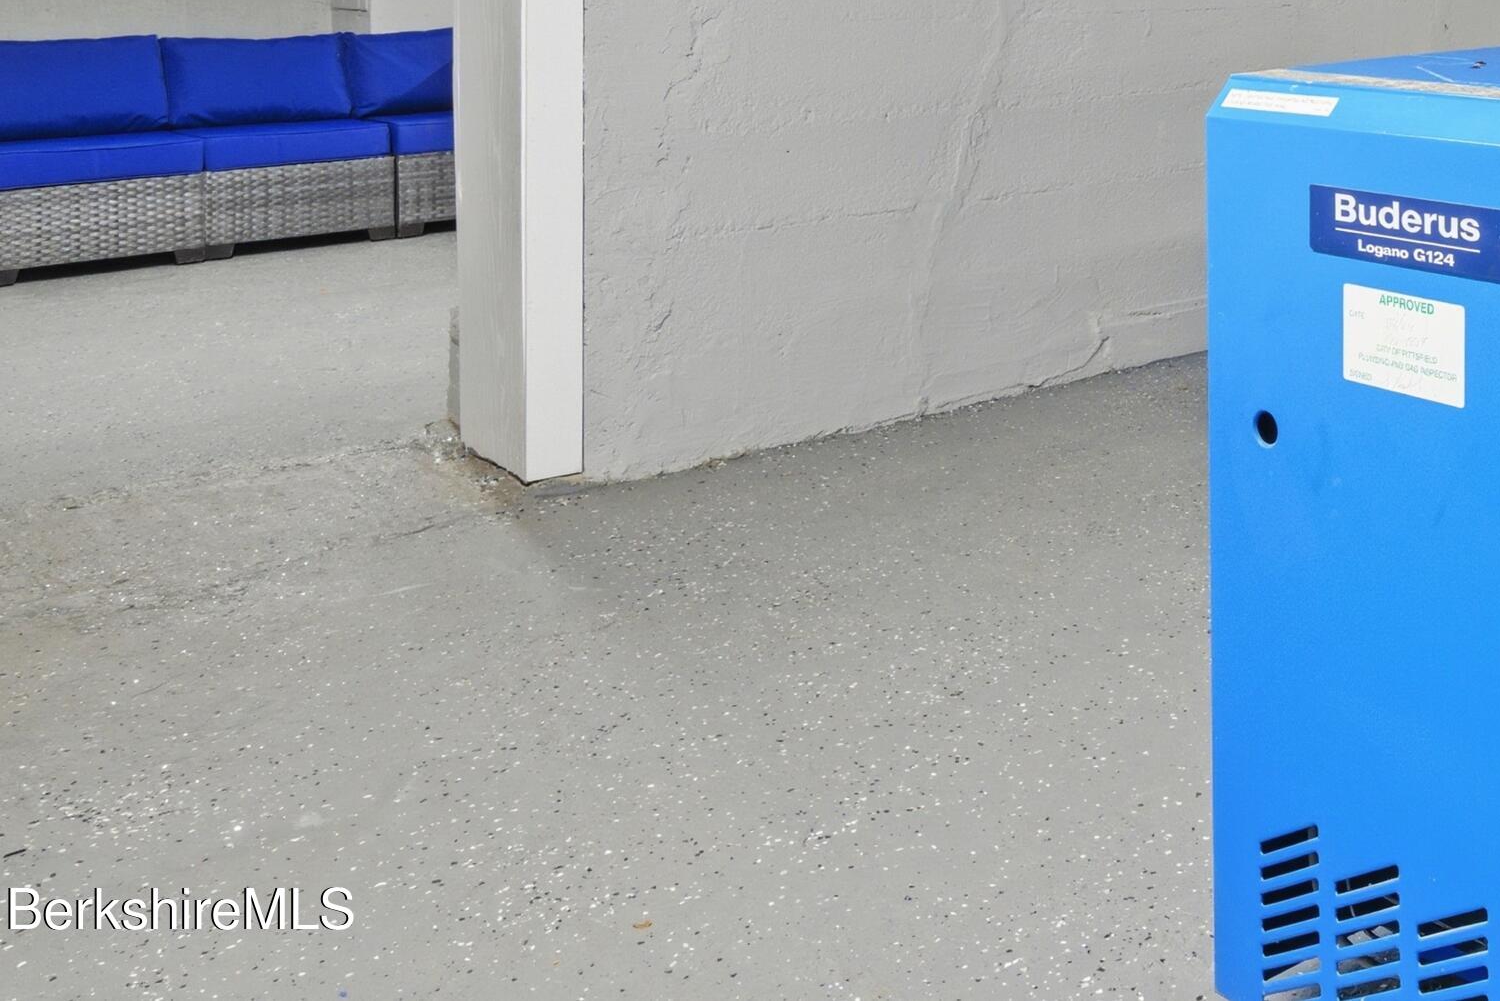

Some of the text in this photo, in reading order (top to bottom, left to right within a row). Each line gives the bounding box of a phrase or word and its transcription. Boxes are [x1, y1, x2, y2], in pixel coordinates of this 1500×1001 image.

[1334, 193, 1481, 242] Buderus
[1358, 239, 1455, 267] Logano G124
[1379, 294, 1435, 315] APPROVED
